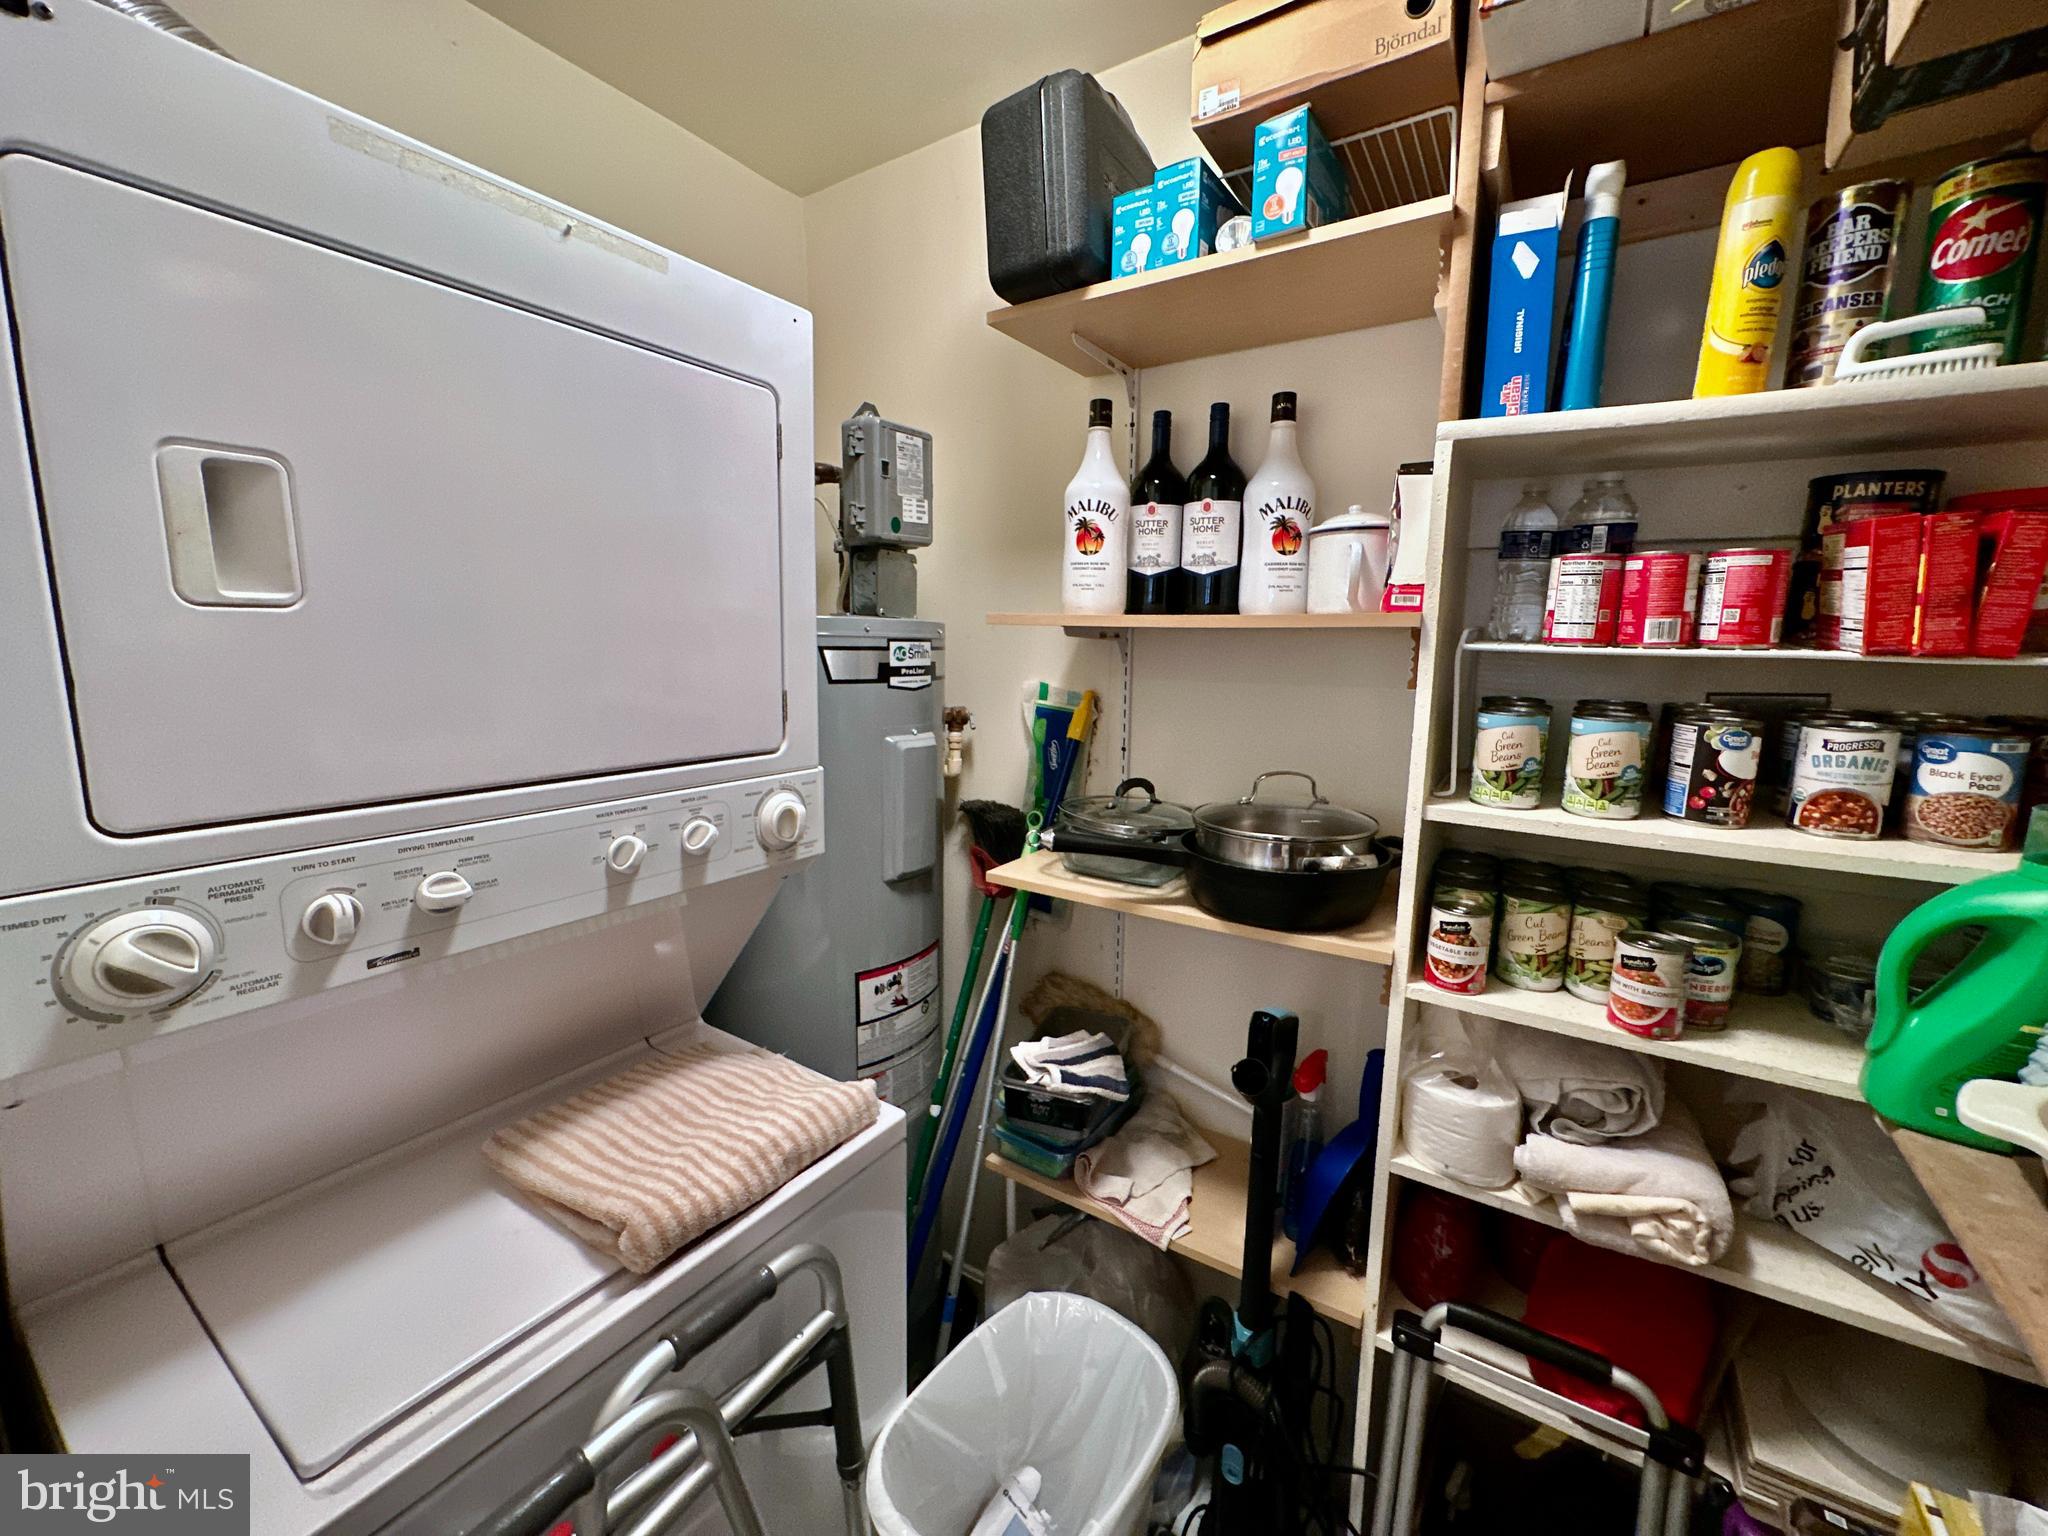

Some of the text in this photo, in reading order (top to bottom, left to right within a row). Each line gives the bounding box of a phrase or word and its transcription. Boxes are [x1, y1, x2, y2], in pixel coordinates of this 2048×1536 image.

[1375, 18, 1442, 58] Björndal
[1827, 214, 1872, 236] BAR
[1931, 226, 2027, 271] Comet
[1810, 244, 1883, 275] FRIEND
[1513, 308, 1526, 354] ORIGINAL
[1831, 481, 1927, 501] PLANTERS
[1067, 498, 1120, 525] MALIBU
[1258, 495, 1313, 522] MALIBU
[1135, 519, 1169, 529] SUTTER
[1189, 516, 1225, 527] SUTTER
[1138, 528, 1165, 536] HOME
[1192, 524, 1221, 534] HOME
[1501, 731, 1515, 741] Cut
[1597, 737, 1613, 748] Cut
[1495, 740, 1524, 752] Green
[1590, 746, 1623, 759] Green
[1825, 740, 1882, 752] PROGRESSO
[1490, 751, 1522, 763] Beans
[1585, 757, 1621, 771] Beans
[1810, 754, 1890, 774] ORGANIC
[1929, 768, 2004, 783] Black Eyed
[1968, 781, 2001, 792] Peas
[397, 836, 475, 854] DRYING TEMPERATURE
[292, 856, 357, 873] TURN TO START
[152, 885, 181, 896] START
[207, 877, 264, 894] AUTOMATIC
[207, 884, 266, 900] PERMANENT
[223, 893, 255, 905] PRESS
[0, 914, 67, 932] TIMED DRY
[1525, 916, 1545, 928] Cut
[1507, 930, 1566, 943] Green Bean
[229, 972, 284, 993] AUTOMATIC
[236, 980, 280, 997] REGULAR
[1622, 982, 1639, 993] WITH
